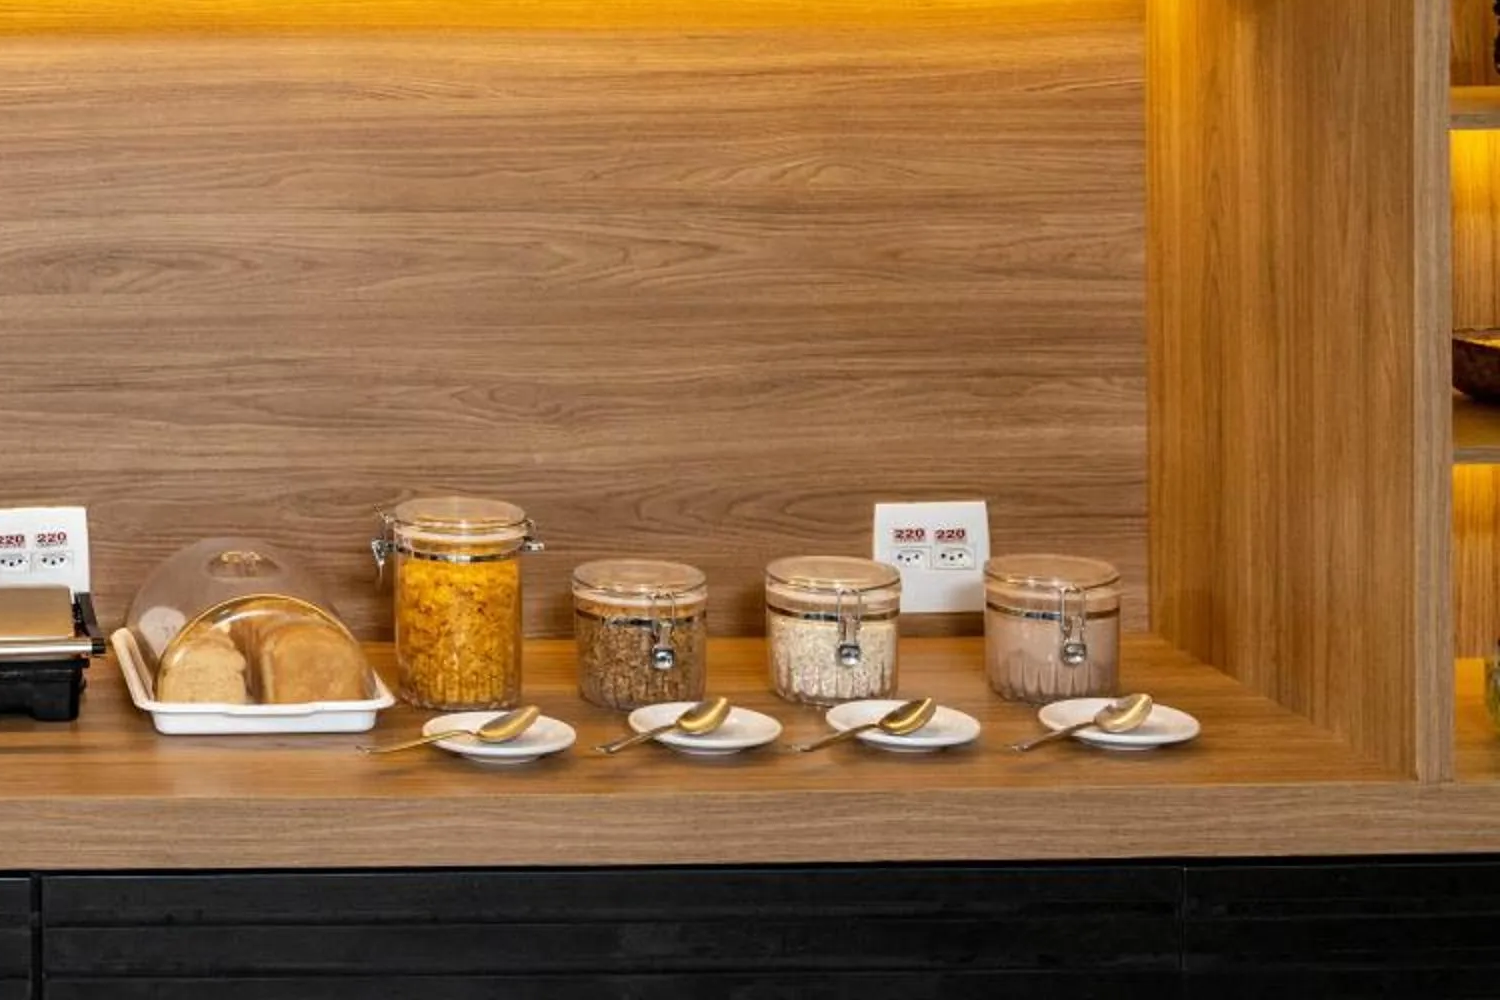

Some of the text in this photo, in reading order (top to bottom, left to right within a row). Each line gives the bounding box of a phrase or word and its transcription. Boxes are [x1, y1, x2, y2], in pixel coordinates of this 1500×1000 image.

[37, 532, 67, 543] 220
[894, 528, 966, 540] 220 220
